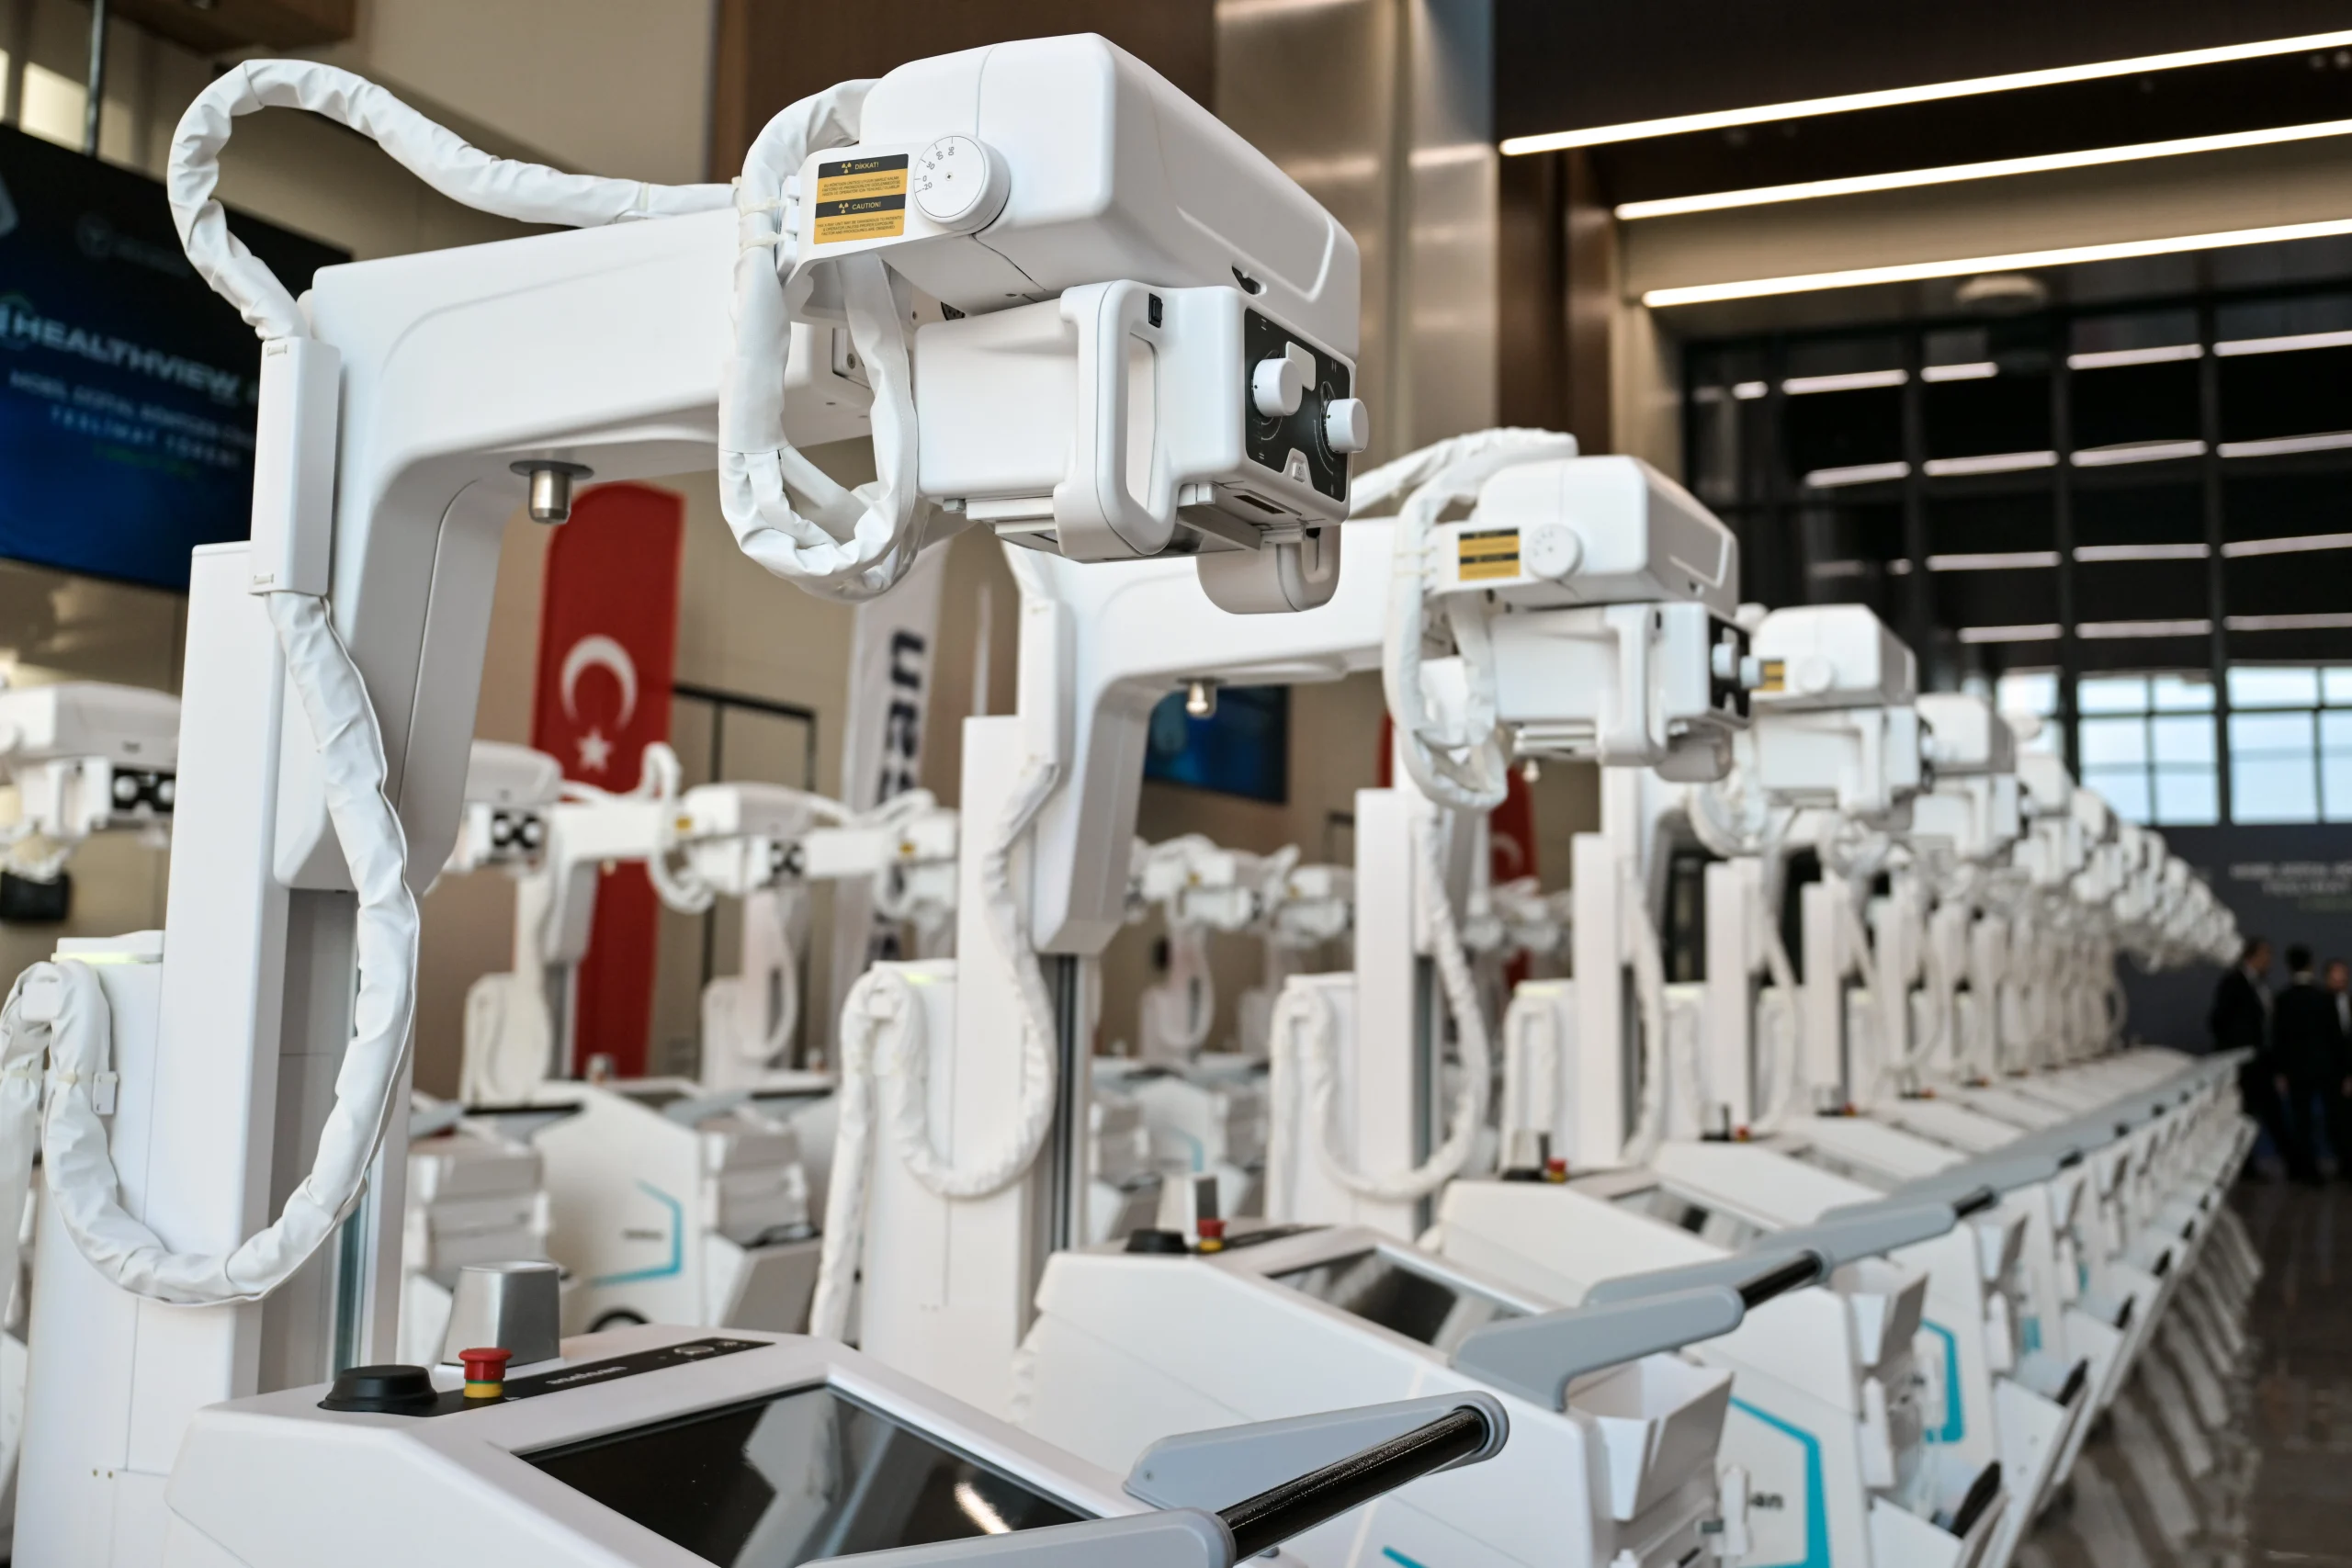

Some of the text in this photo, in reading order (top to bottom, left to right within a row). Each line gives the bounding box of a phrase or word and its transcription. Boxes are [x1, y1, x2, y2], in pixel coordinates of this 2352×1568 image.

[948, 146, 955, 156] 90
[936, 152, 944, 161] 60
[855, 162, 879, 170] DİKKAT!
[926, 161, 935, 170] 30
[922, 181, 933, 191] -20
[852, 201, 881, 209] CAUTION!
[12, 310, 241, 406] HEALTHVIEW
